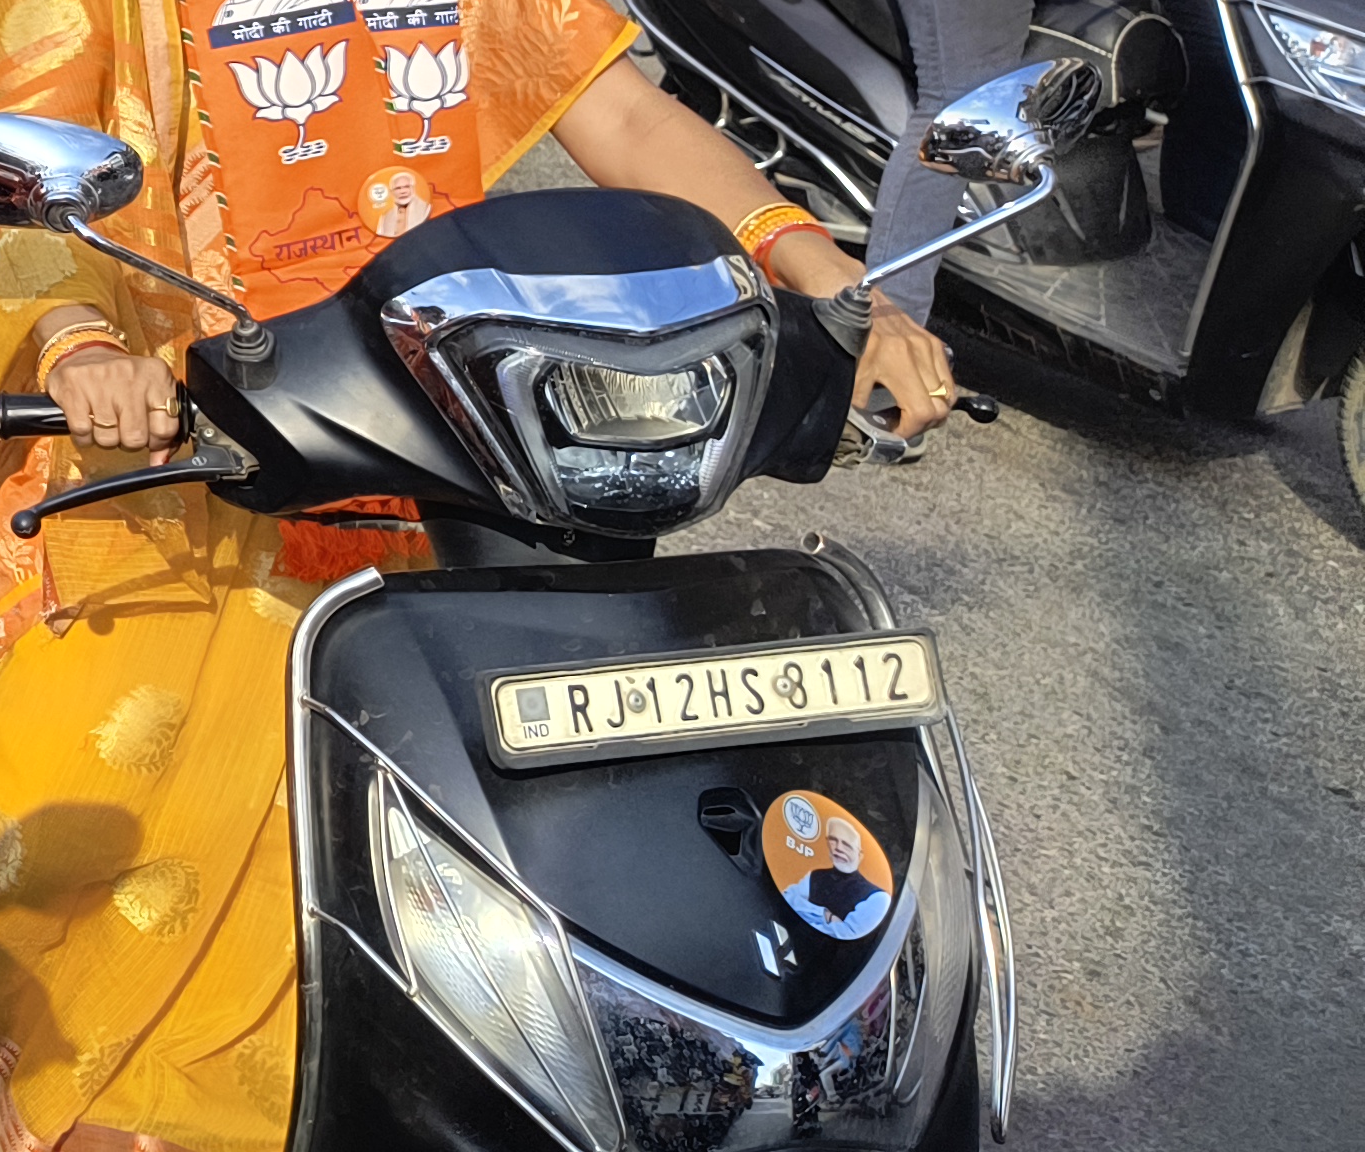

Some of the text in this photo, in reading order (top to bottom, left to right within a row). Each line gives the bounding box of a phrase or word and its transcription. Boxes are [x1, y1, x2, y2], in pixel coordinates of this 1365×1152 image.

[232, 8, 333, 41] मोदी की गारंटी
[365, 11, 399, 30] मोदी
[406, 8, 427, 26] की
[273, 224, 362, 262] राजस्थान
[568, 652, 909, 735] RJ12HS8112
[523, 722, 550, 739] IND
[785, 835, 816, 859] BJP
